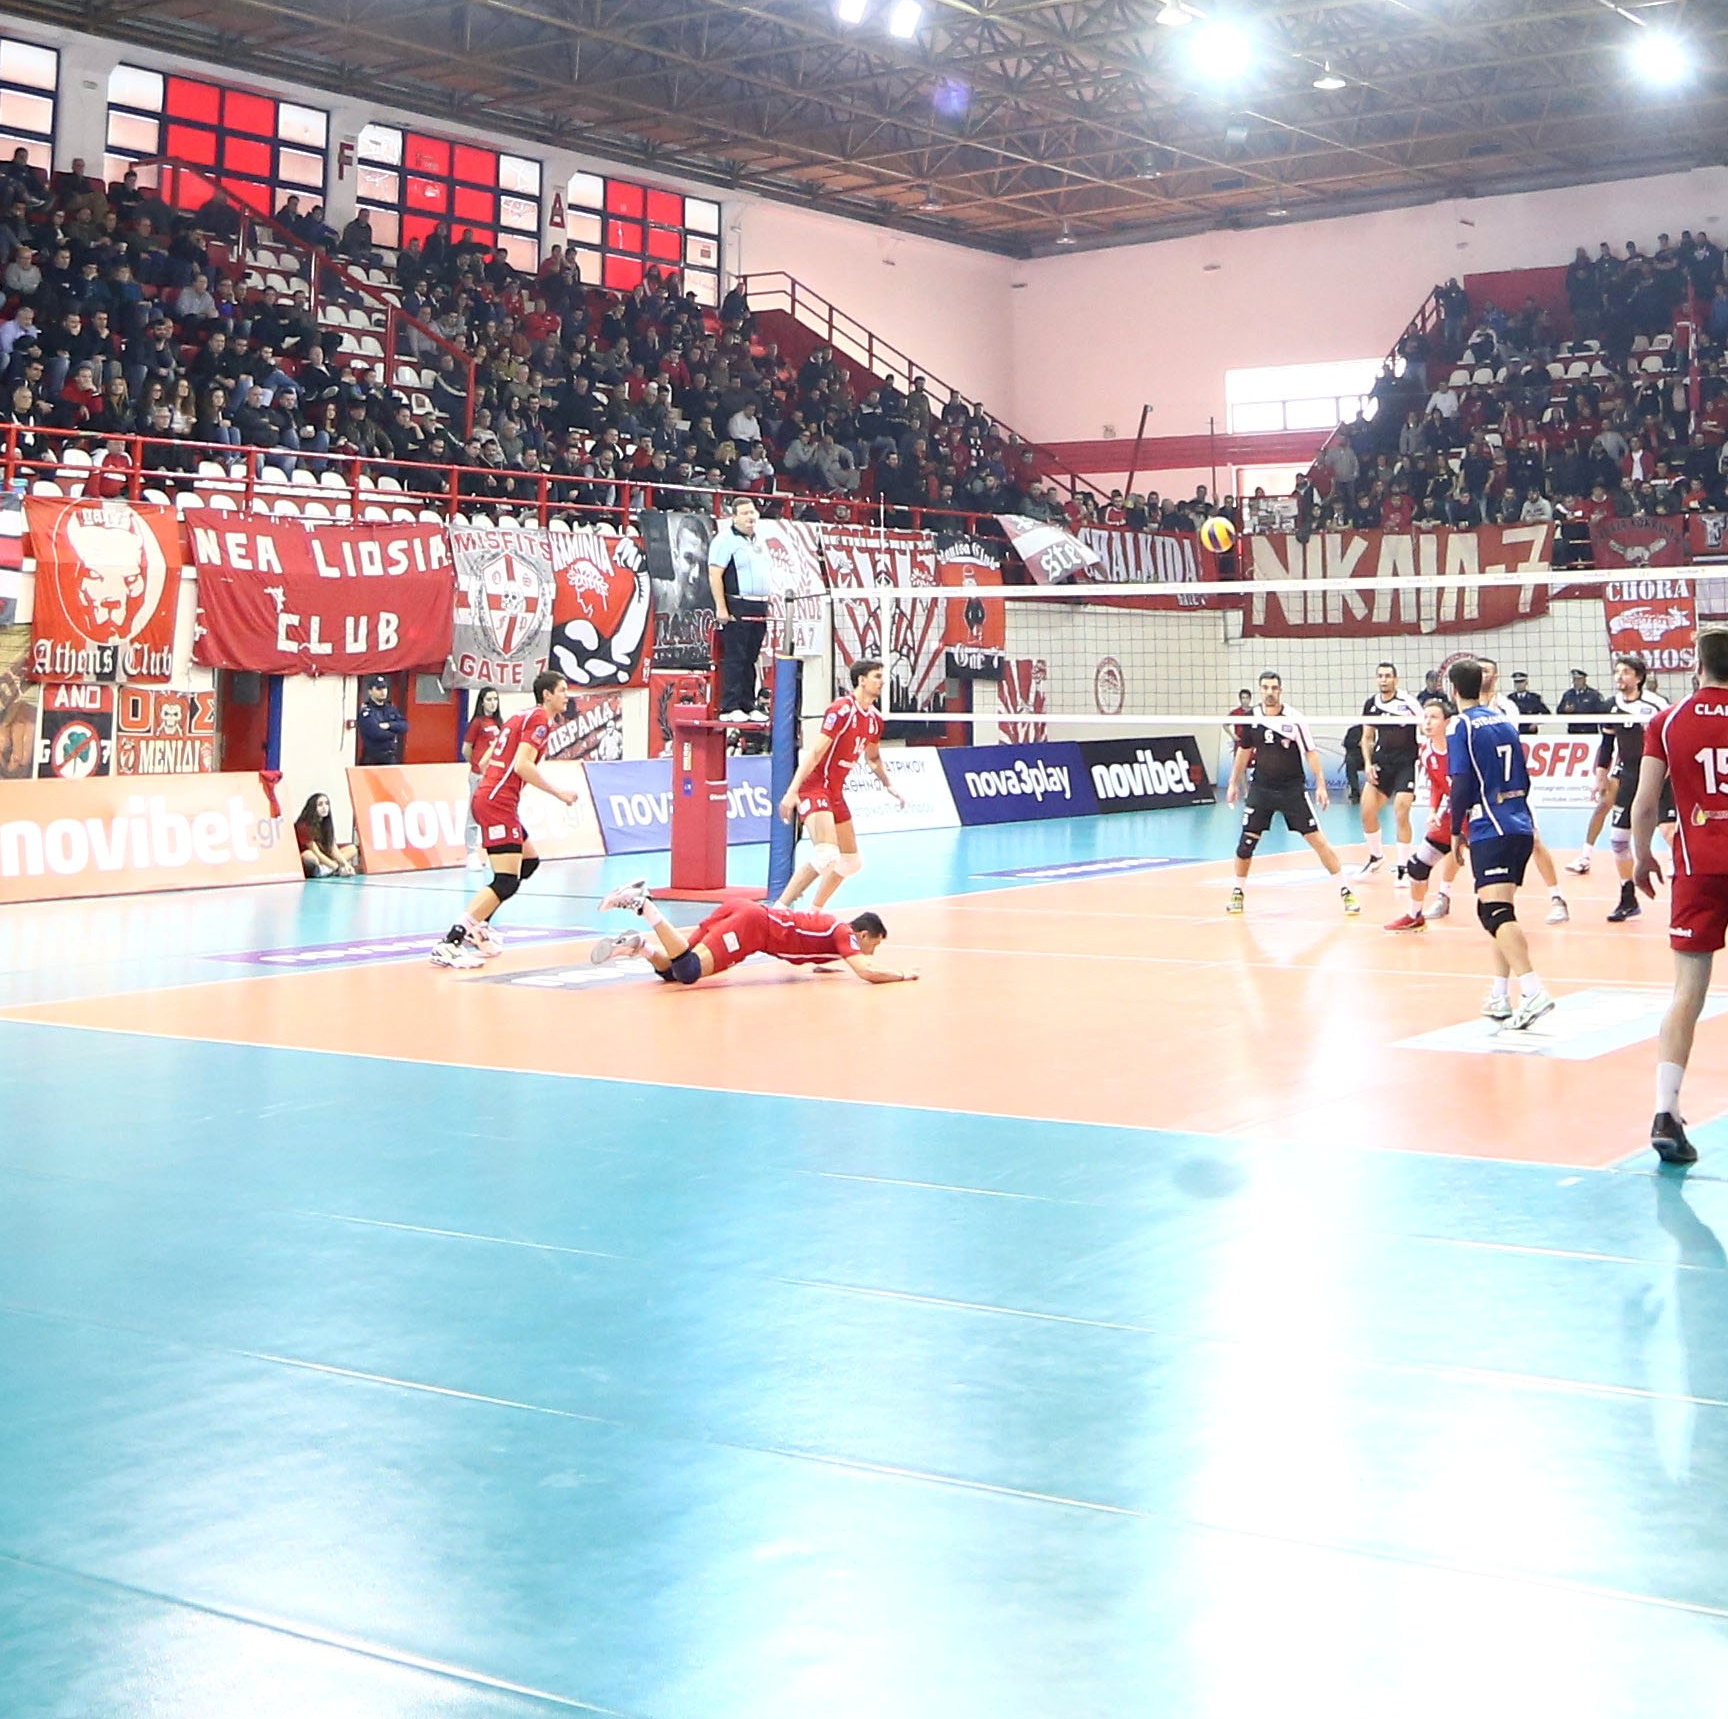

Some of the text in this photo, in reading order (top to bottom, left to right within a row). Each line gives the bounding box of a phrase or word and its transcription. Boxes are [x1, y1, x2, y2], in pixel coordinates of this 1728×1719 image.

[193, 526, 450, 579] NEA LIOSIA
[454, 531, 552, 562] MISFITS
[276, 611, 399, 656] CLUB
[123, 642, 172, 677] Club
[458, 653, 523, 685] GATE
[54, 684, 102, 709] ANO
[964, 759, 1072, 802] nova3play
[1091, 748, 1197, 800] novibet
[1495, 744, 1513, 782] 7
